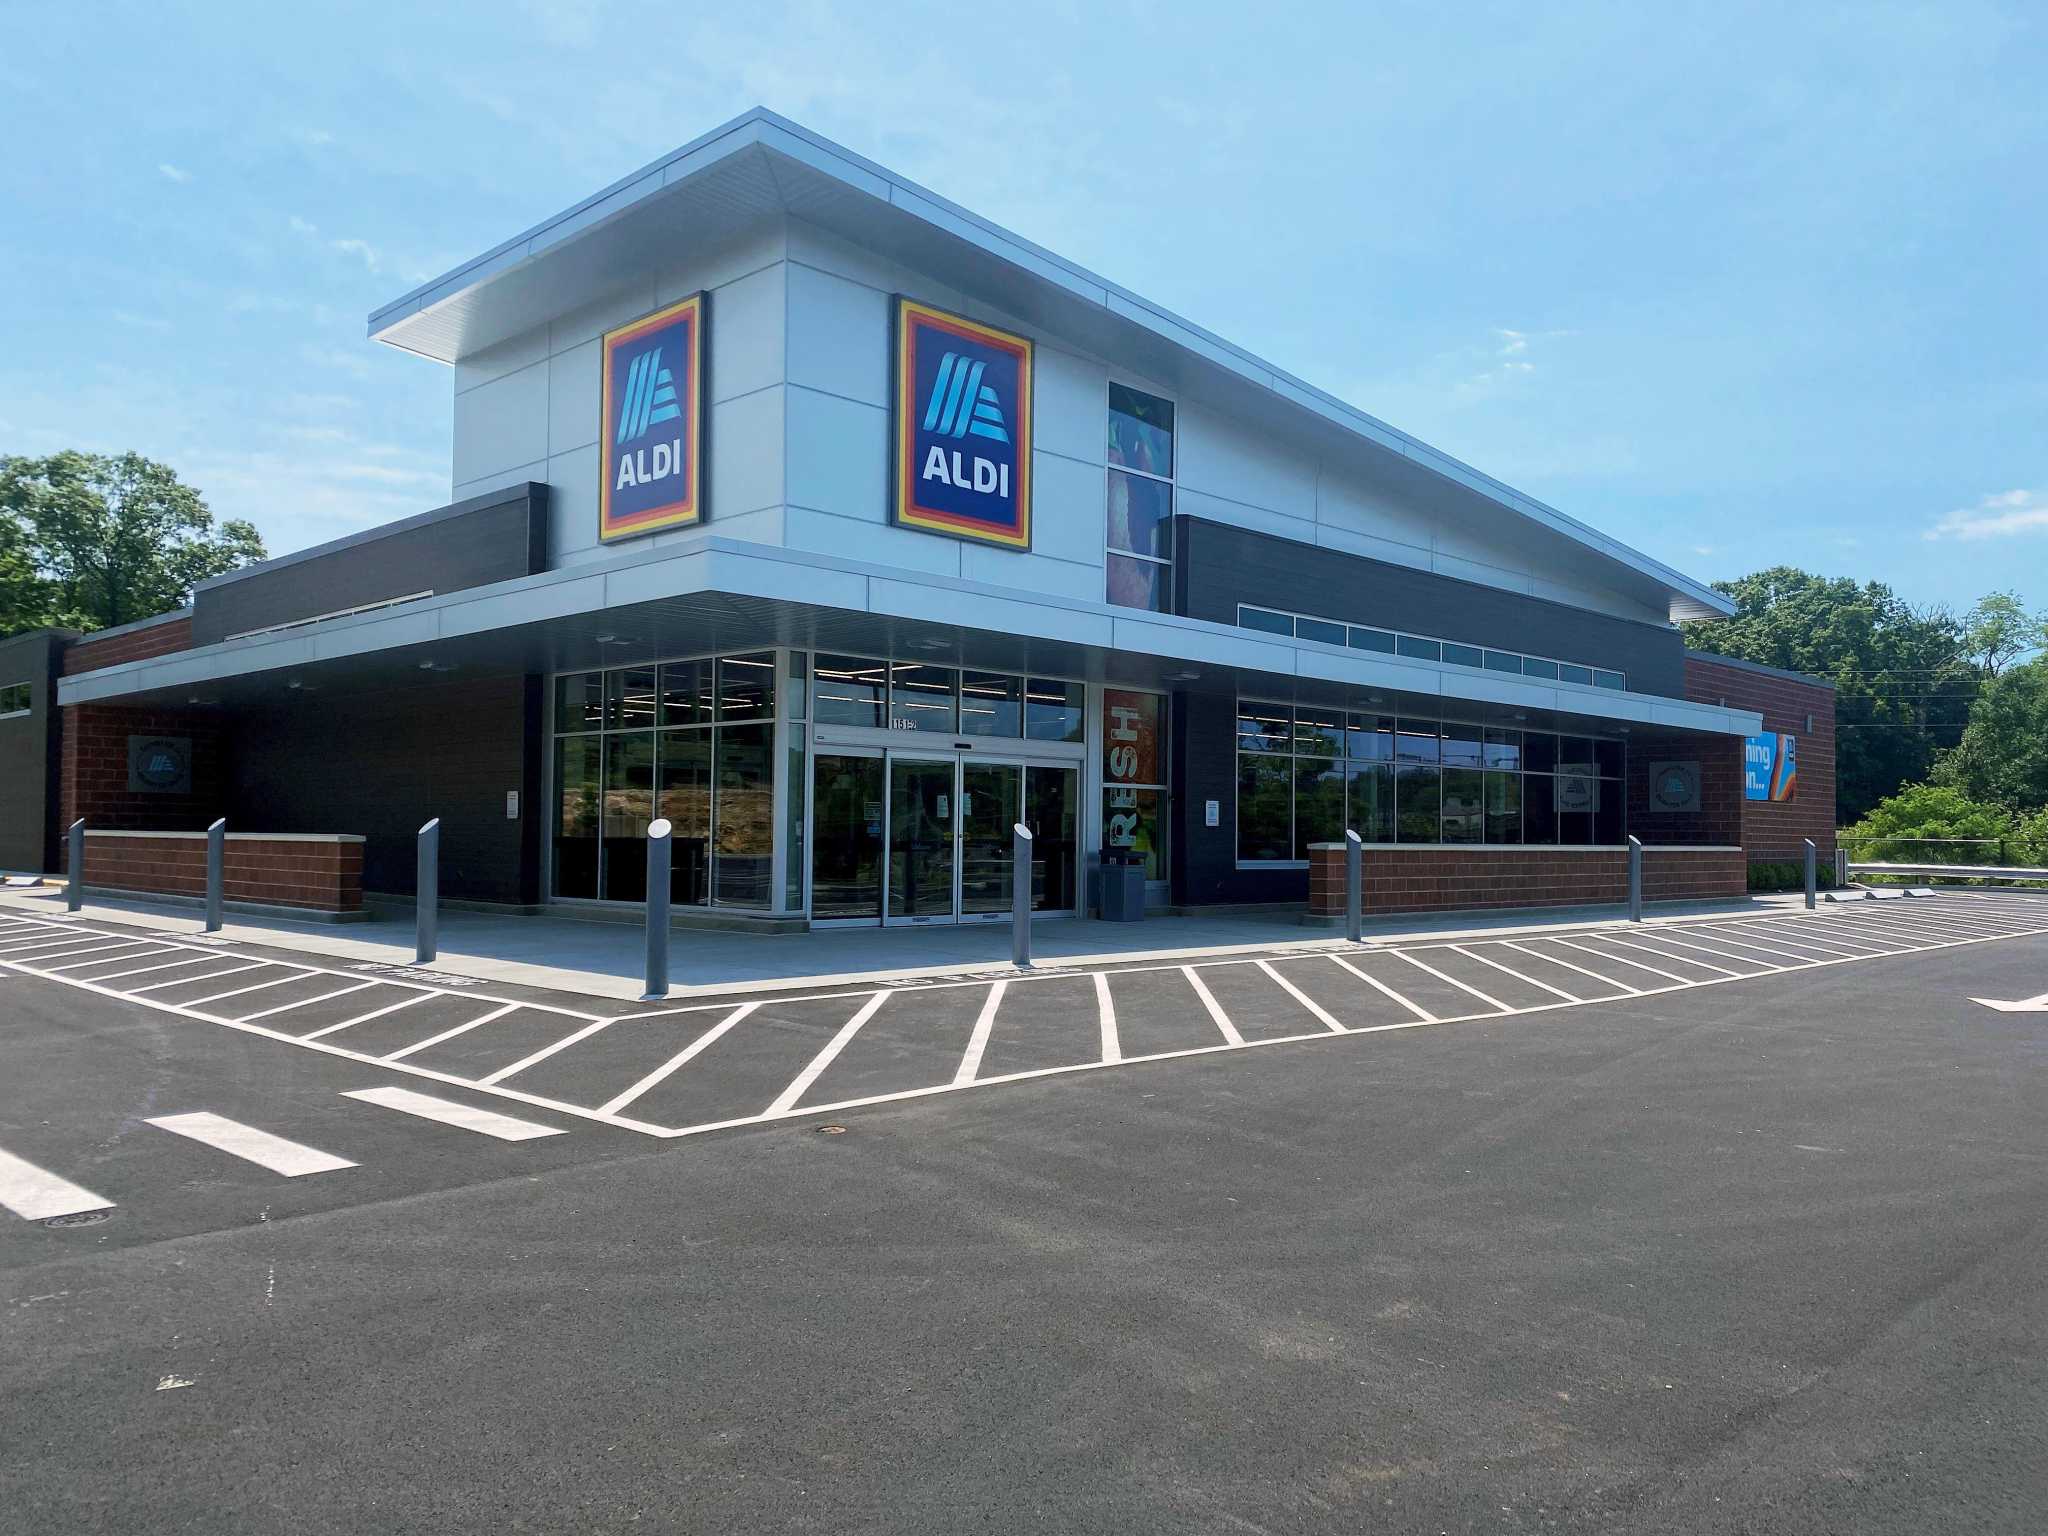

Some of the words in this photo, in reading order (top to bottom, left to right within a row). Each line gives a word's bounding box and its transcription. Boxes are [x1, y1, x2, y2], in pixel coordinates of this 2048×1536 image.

[616, 438, 681, 490] ALDI
[922, 446, 1009, 498] ALDI
[1745, 738, 1770, 770] ning
[1109, 706, 1138, 864] RESH
